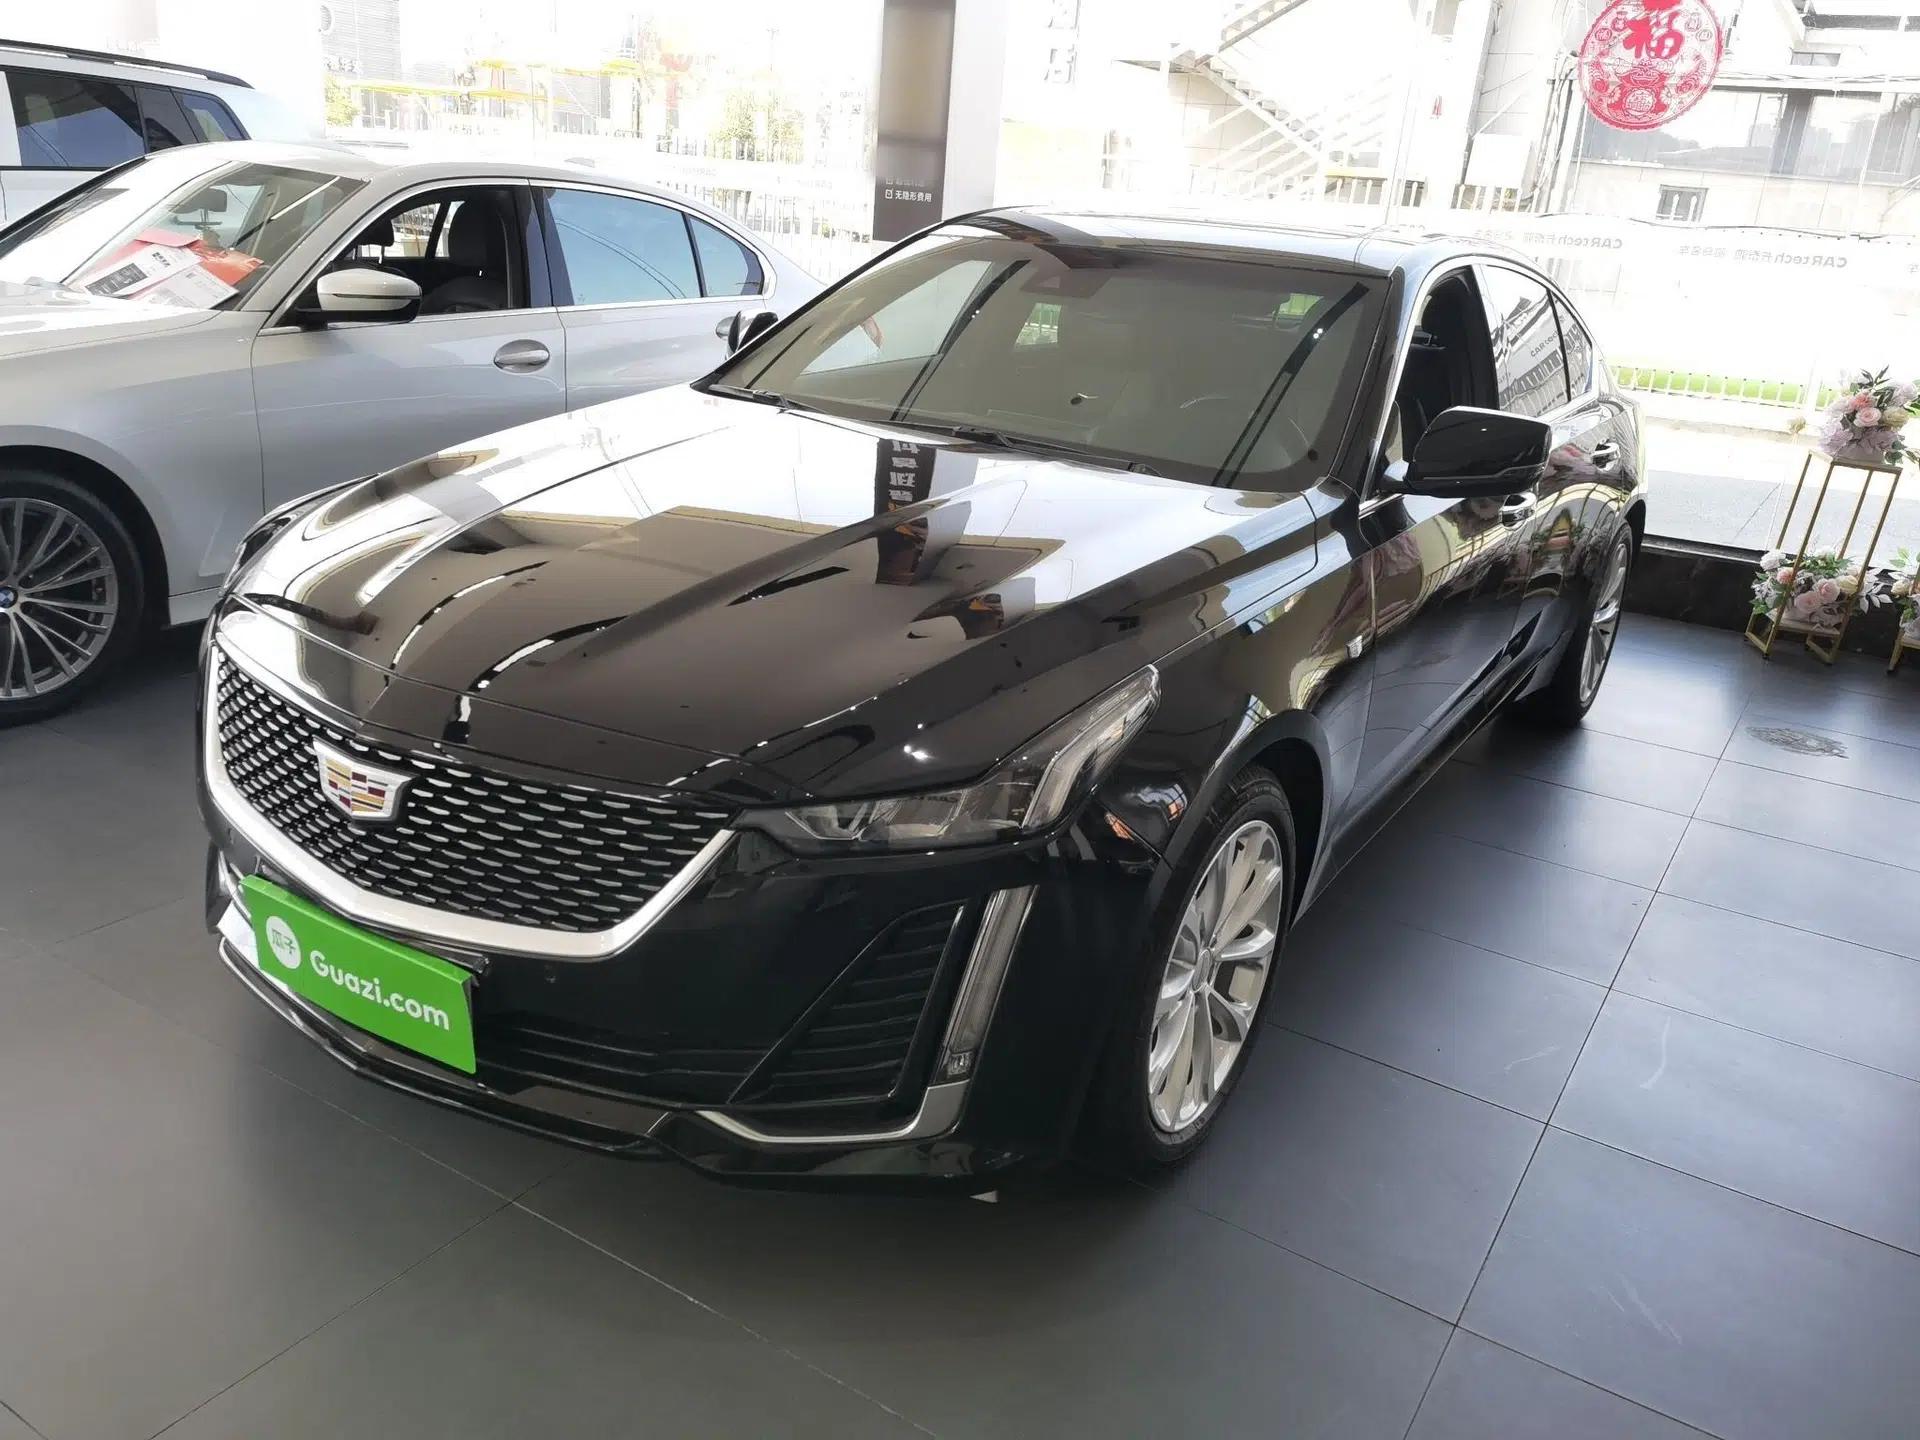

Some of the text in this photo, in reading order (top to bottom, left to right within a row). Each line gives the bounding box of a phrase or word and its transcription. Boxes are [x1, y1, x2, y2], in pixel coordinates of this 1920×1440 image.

[894, 190, 932, 203] 无隐形费用
[272, 928, 296, 955] 瓜子
[310, 950, 450, 1030] Guazi.com
